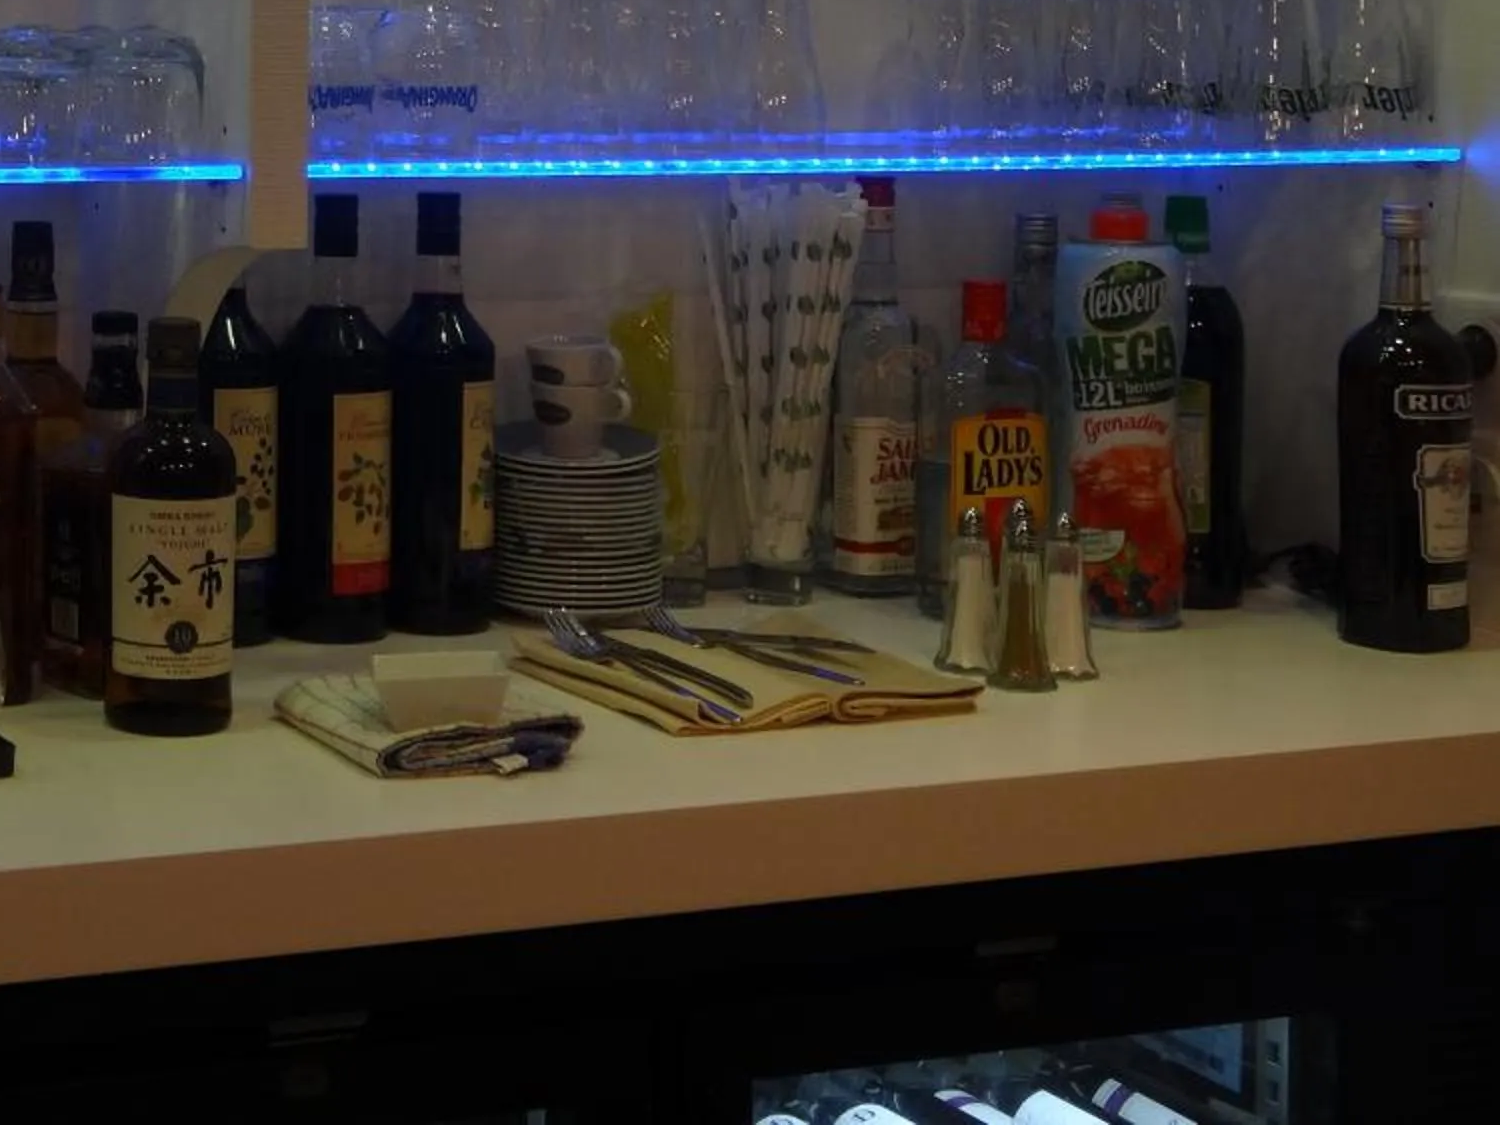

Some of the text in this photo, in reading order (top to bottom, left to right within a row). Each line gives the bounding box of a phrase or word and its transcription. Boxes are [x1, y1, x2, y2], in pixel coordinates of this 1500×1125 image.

[1067, 326, 1177, 380] MEGA
[1408, 393, 1473, 412] RICA
[877, 438, 918, 460] SAI
[978, 422, 1031, 457] OLD
[870, 463, 916, 484] JAM
